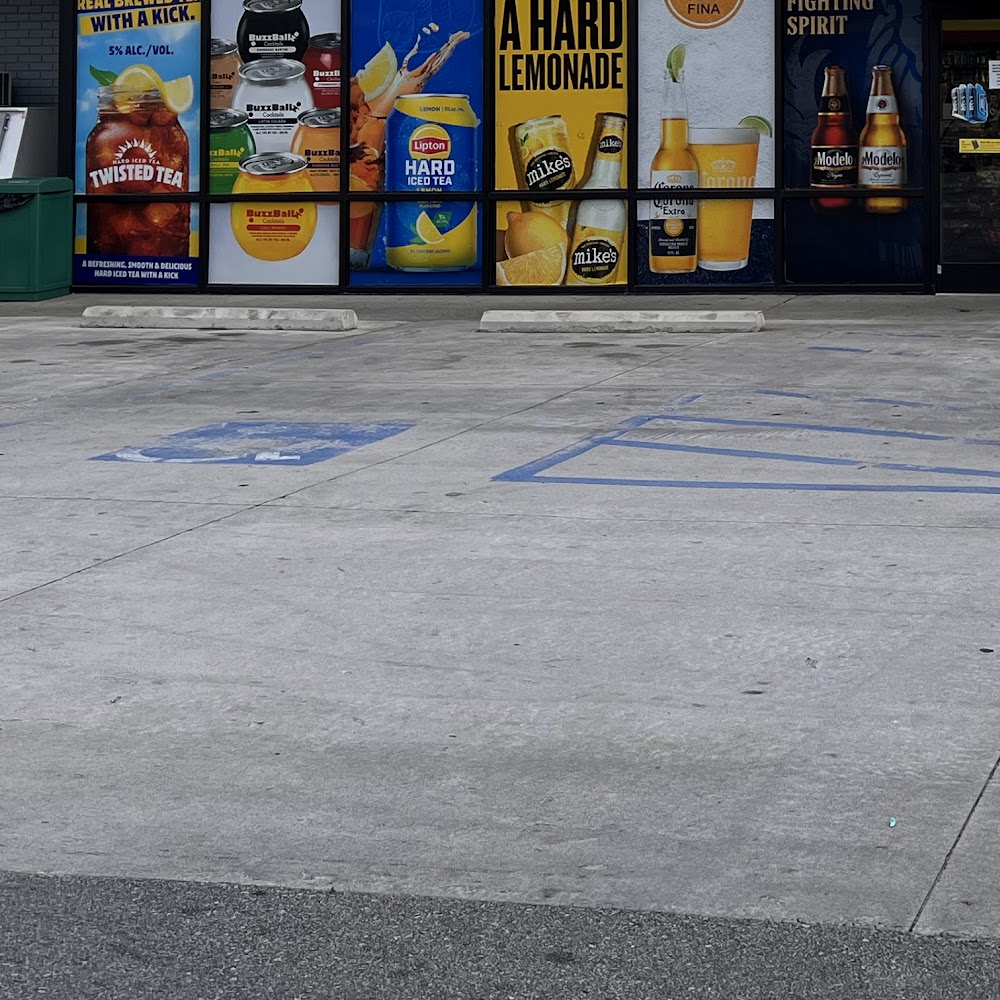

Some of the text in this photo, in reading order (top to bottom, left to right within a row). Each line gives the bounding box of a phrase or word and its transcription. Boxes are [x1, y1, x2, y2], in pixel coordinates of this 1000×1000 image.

[687, 3, 721, 15] FINA
[90, 5, 196, 33] WITH A KICK.
[786, 15, 848, 36] SPIRIT
[109, 44, 174, 57] 5% ALC./VOL.
[499, 52, 624, 91] LEMONADE
[414, 140, 446, 152] Lipton
[599, 138, 622, 149] mike's
[817, 151, 853, 167] Modelo
[863, 151, 901, 166] Modelo
[405, 159, 455, 176] HARD
[527, 155, 571, 186] mike's
[89, 164, 154, 188] TWISTED
[156, 166, 183, 188] TEA
[408, 176, 453, 186] ICED TEA
[663, 206, 685, 216] Extra
[574, 247, 617, 266] mike's
[128, 261, 153, 269] SMOOTH
[161, 261, 192, 270] DELICIOUS
[94, 269, 112, 277] HARD
[113, 270, 127, 278] ICED
[128, 270, 140, 278] TEA
[164, 271, 179, 279] KICK
